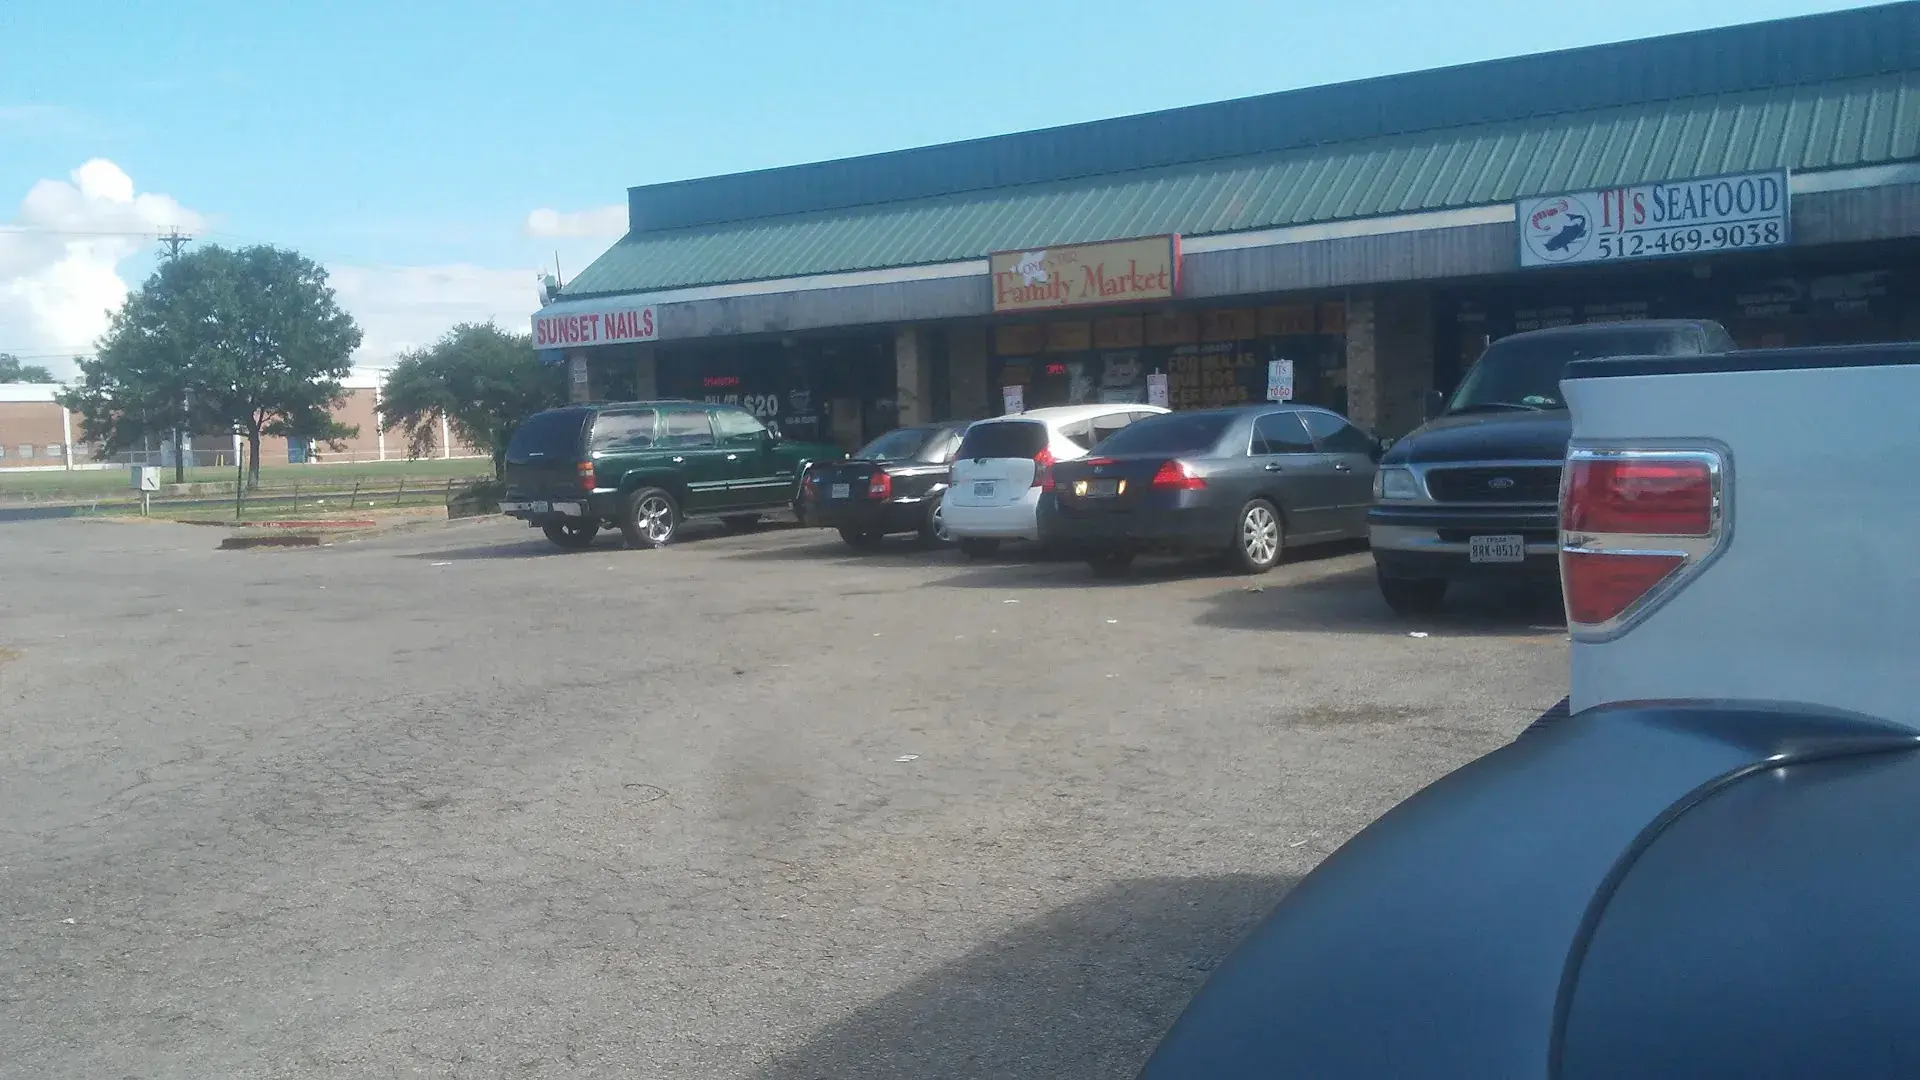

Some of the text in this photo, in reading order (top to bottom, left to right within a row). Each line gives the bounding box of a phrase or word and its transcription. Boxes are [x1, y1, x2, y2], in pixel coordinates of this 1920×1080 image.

[1652, 176, 1779, 223] SEAFOOD
[1598, 221, 1781, 260] 512-469-9038
[993, 259, 1169, 305] Family Market
[536, 309, 654, 345] SUNSET NAILS
